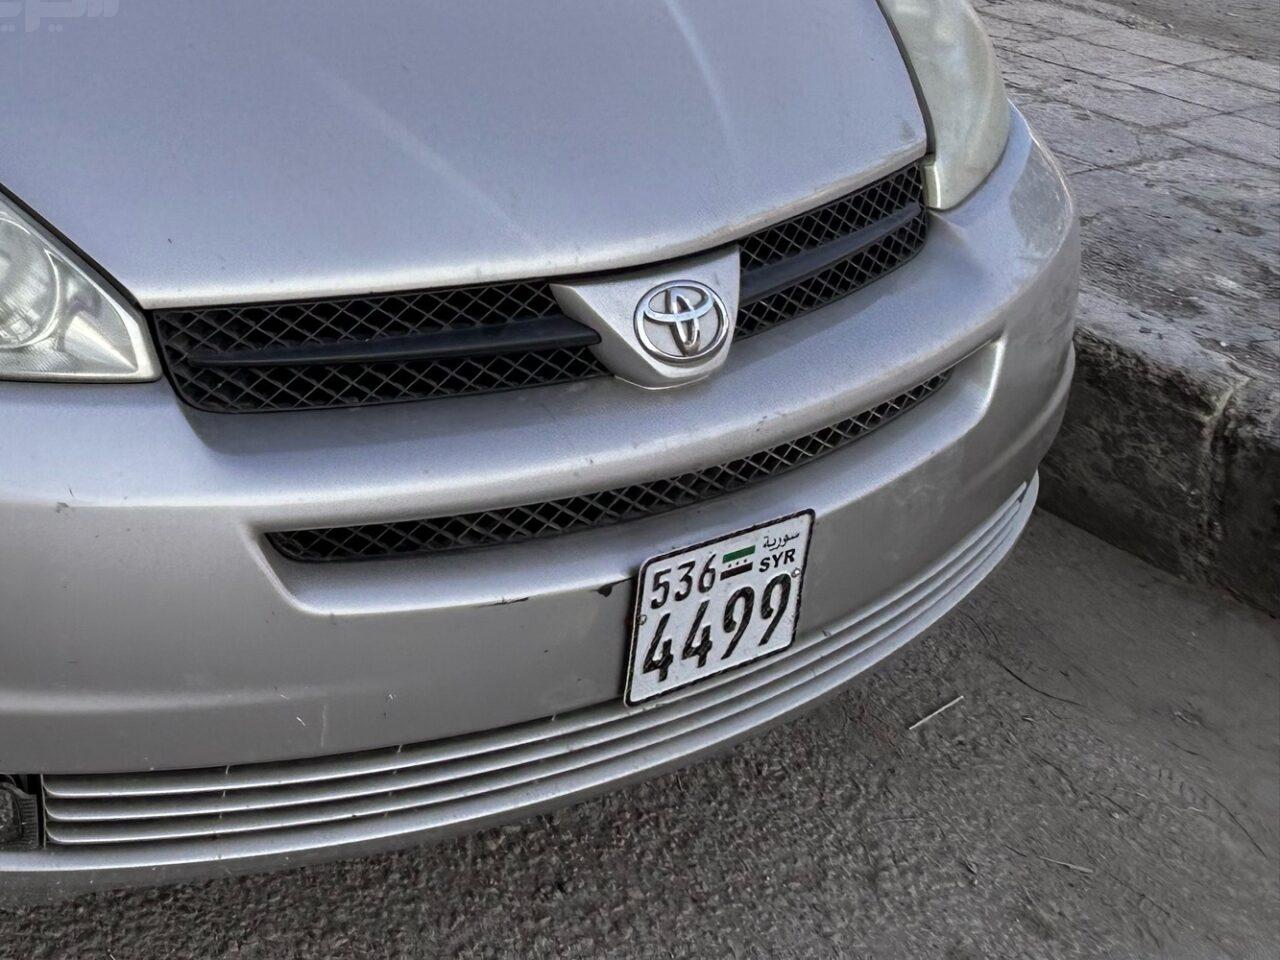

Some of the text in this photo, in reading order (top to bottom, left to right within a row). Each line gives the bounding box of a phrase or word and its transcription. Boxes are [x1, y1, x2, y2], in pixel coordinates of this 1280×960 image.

[759, 548, 796, 573] SYR
[762, 532, 800, 552] سورية
[650, 553, 717, 610] 536
[642, 572, 793, 683] 4499
